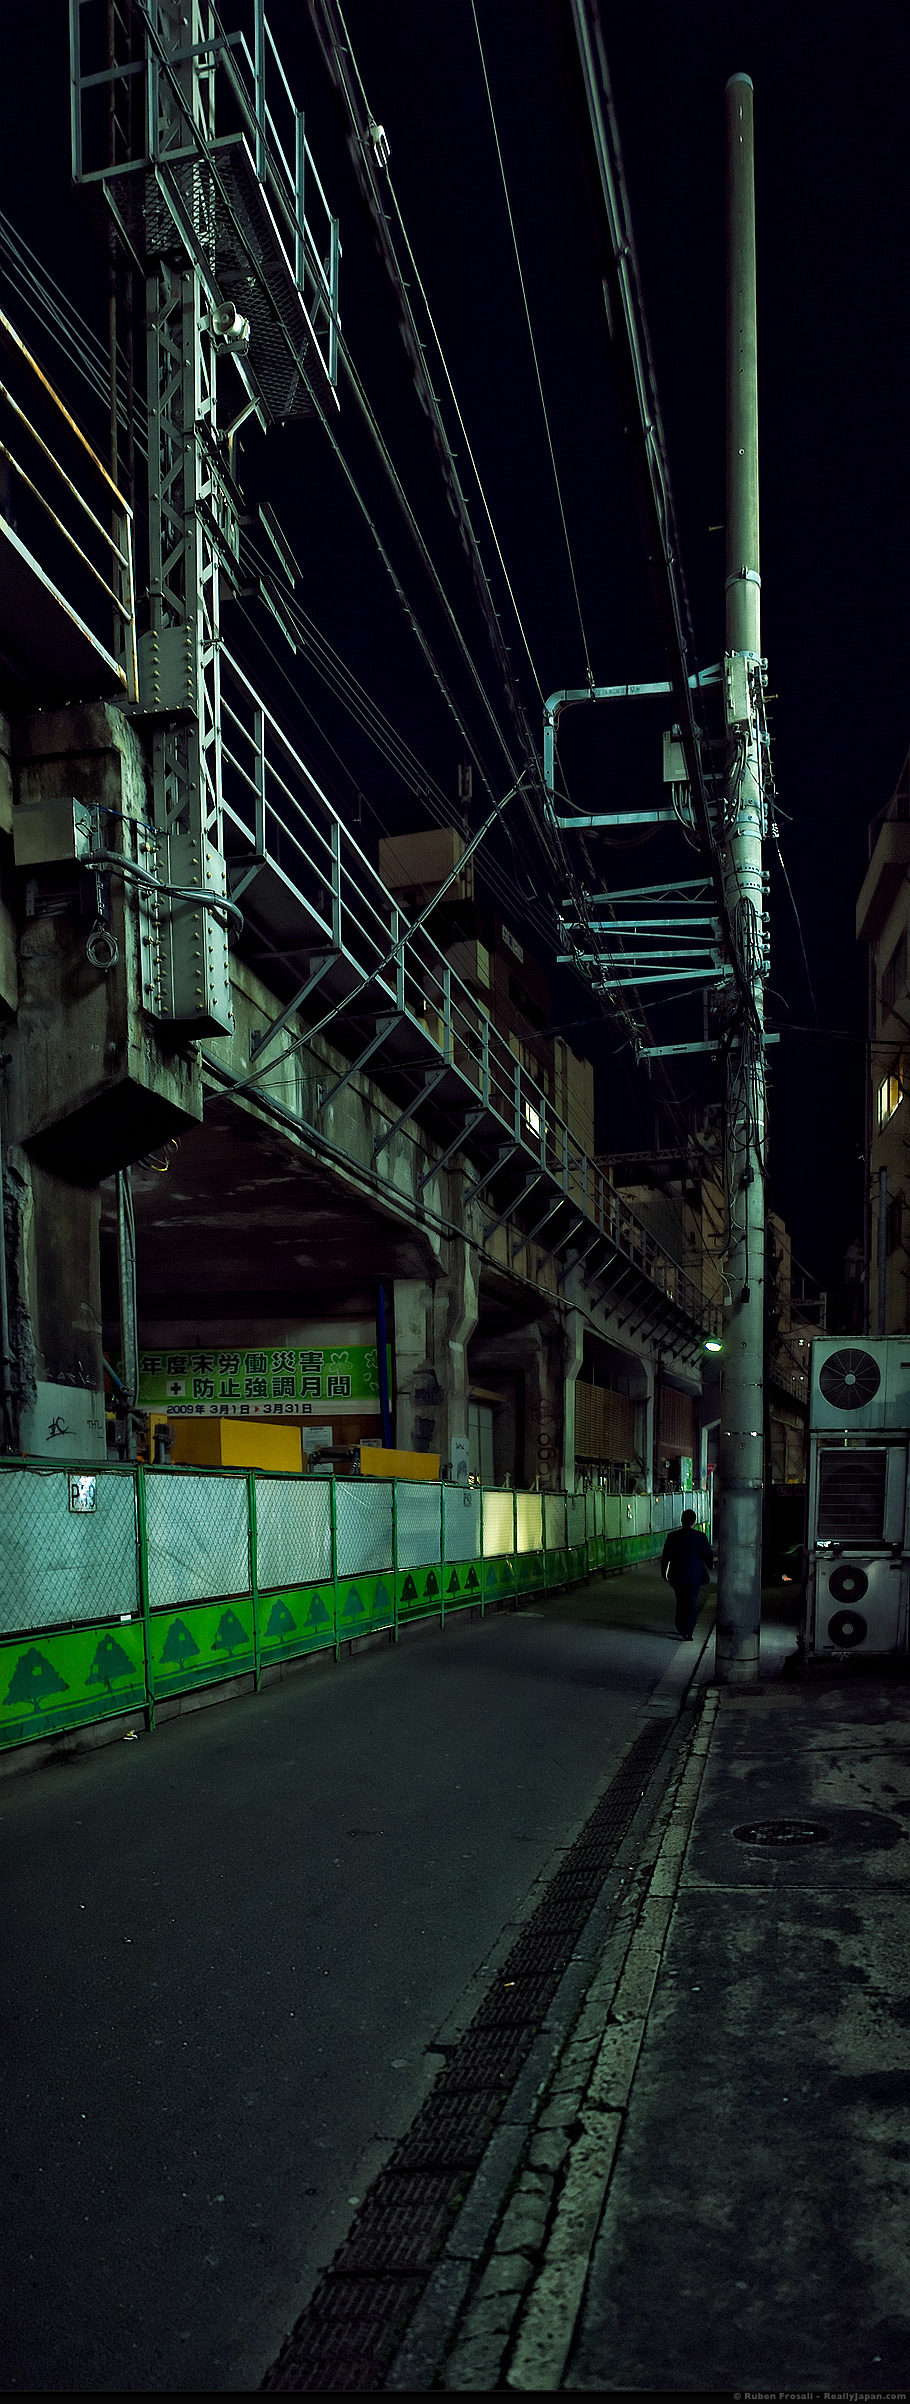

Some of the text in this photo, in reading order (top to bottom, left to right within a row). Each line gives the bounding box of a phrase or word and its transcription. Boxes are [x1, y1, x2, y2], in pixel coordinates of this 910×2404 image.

[141, 1350, 325, 1376] 年度末労働災害
[192, 1375, 352, 1399] 防止強調月間
[166, 1403, 313, 1414] 2009年 3月1日 3月31日
